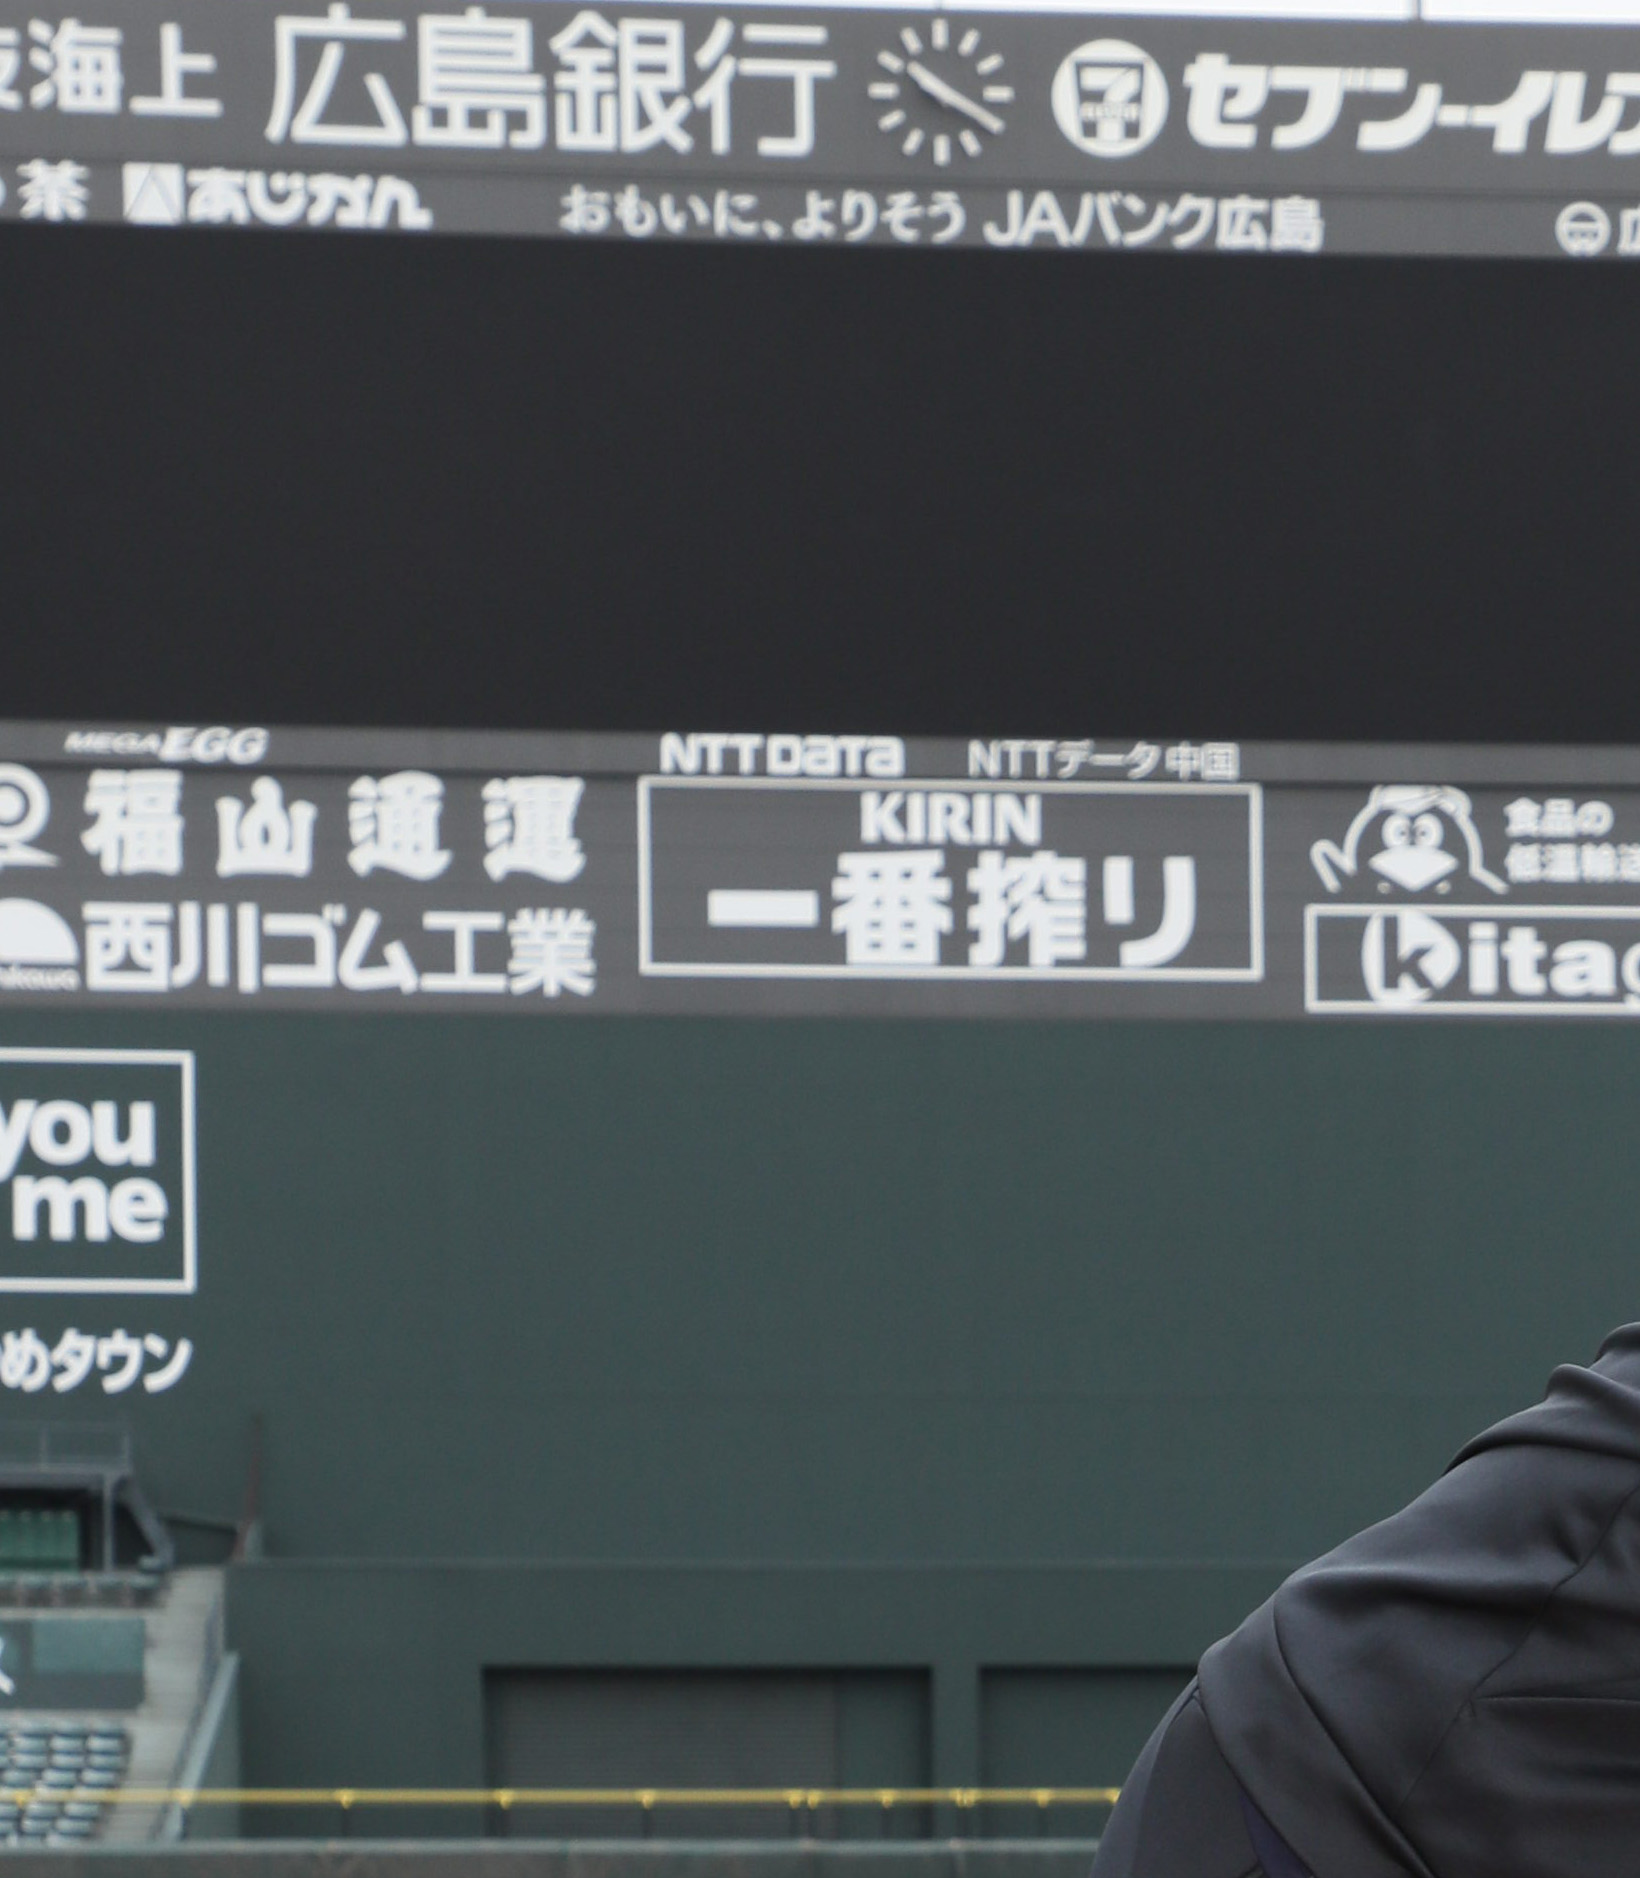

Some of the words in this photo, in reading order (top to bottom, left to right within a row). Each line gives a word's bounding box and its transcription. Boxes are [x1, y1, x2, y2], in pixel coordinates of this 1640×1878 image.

[266, 3, 837, 155] 広島銀行
[983, 190, 1324, 251] JAバンク広島
[967, 740, 1240, 781] NTTデータ中国
[81, 769, 587, 882] 福山通運
[860, 792, 1042, 845] KIRIN
[1503, 797, 1615, 838] 食品の
[706, 849, 1196, 968] 一番搾り
[82, 901, 596, 996] 西川ゴム工業
[12, 1175, 168, 1243] me
[0, 1328, 193, 1393] めタウン
